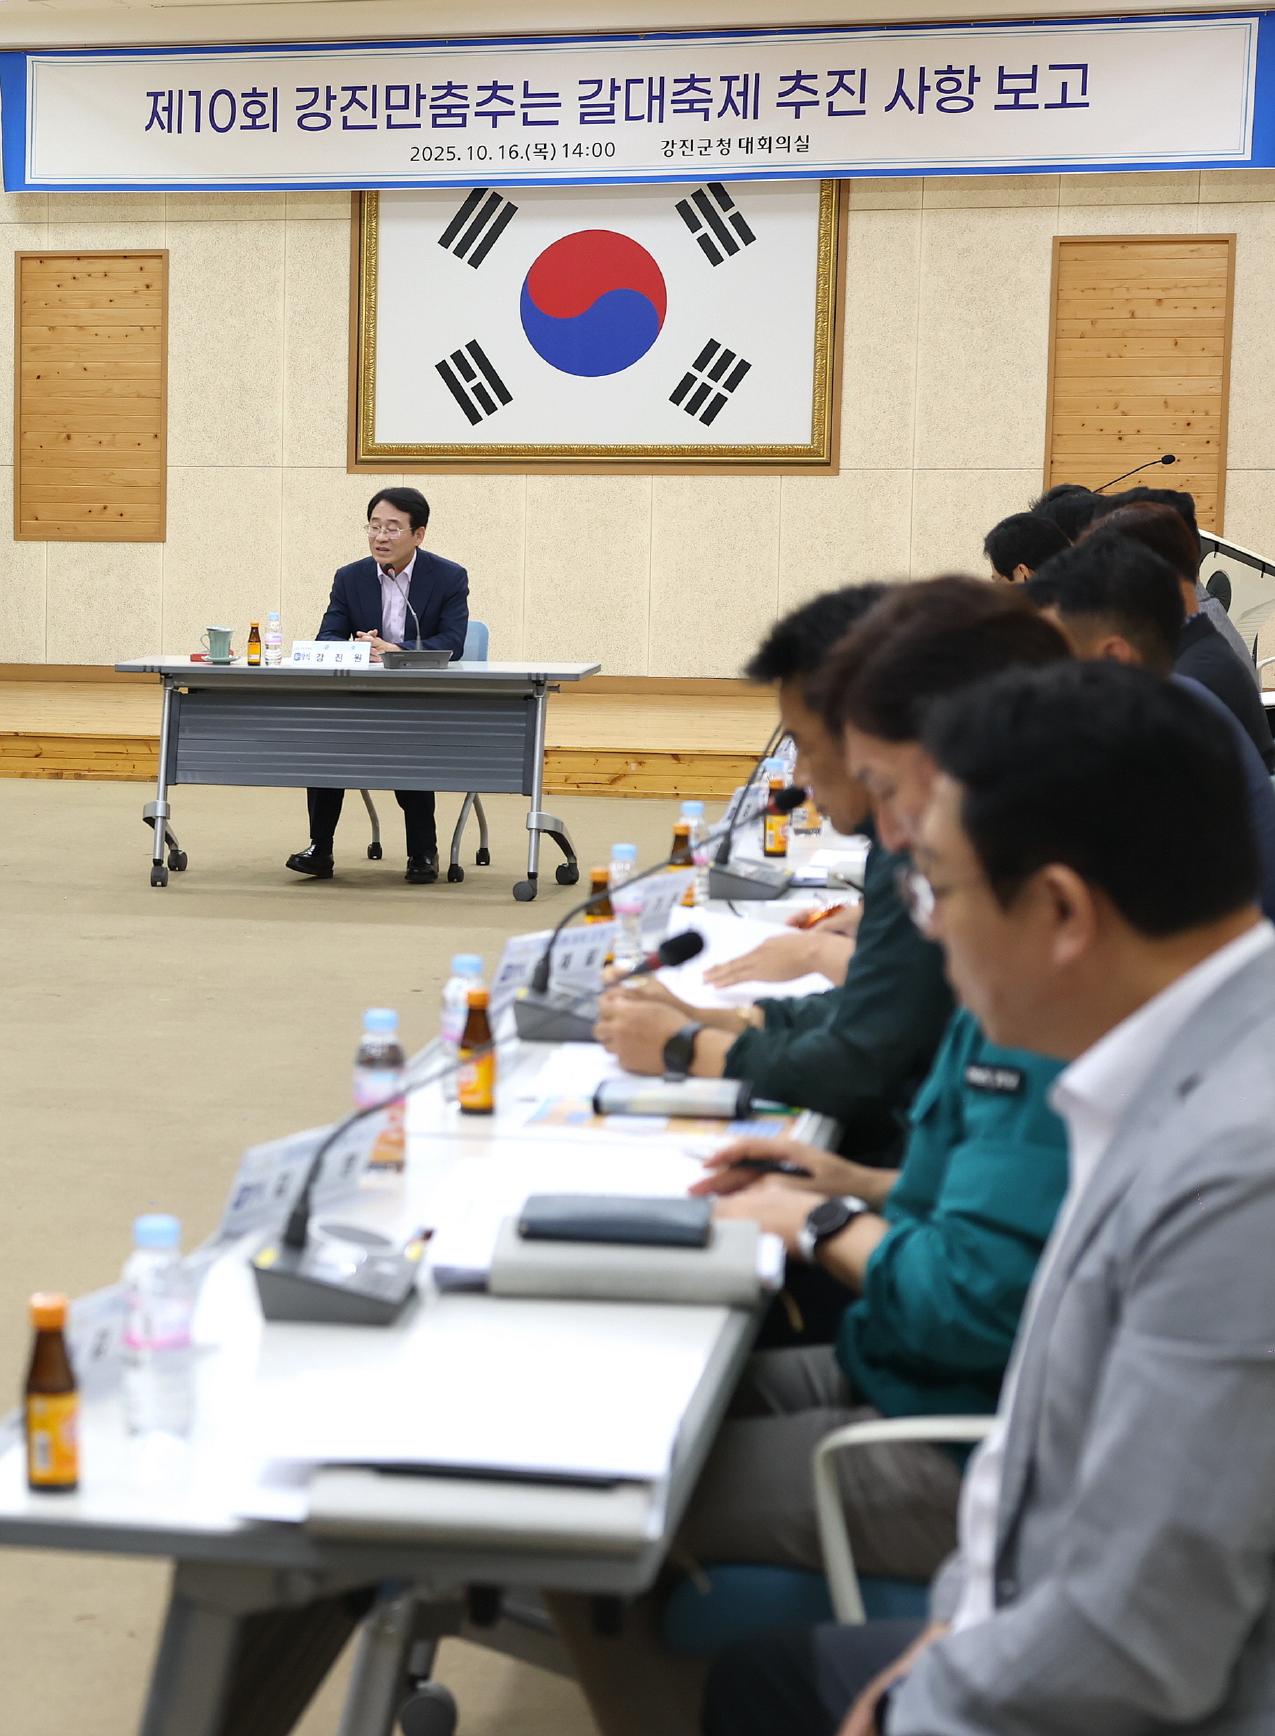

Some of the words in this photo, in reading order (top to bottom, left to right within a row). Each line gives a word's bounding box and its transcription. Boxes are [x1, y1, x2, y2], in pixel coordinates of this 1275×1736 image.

[144, 86, 278, 134] 제10회
[295, 80, 562, 132] 강진만춤추는
[578, 72, 760, 125] 갈대축제
[775, 67, 867, 119] 추진
[884, 64, 981, 115] 사항
[993, 63, 1090, 111] 보고
[410, 146, 461, 162] 2025.
[467, 145, 493, 161] 10.
[562, 141, 616, 159] 14:00
[661, 137, 731, 158] 강진군청
[738, 134, 810, 155] 대회의실
